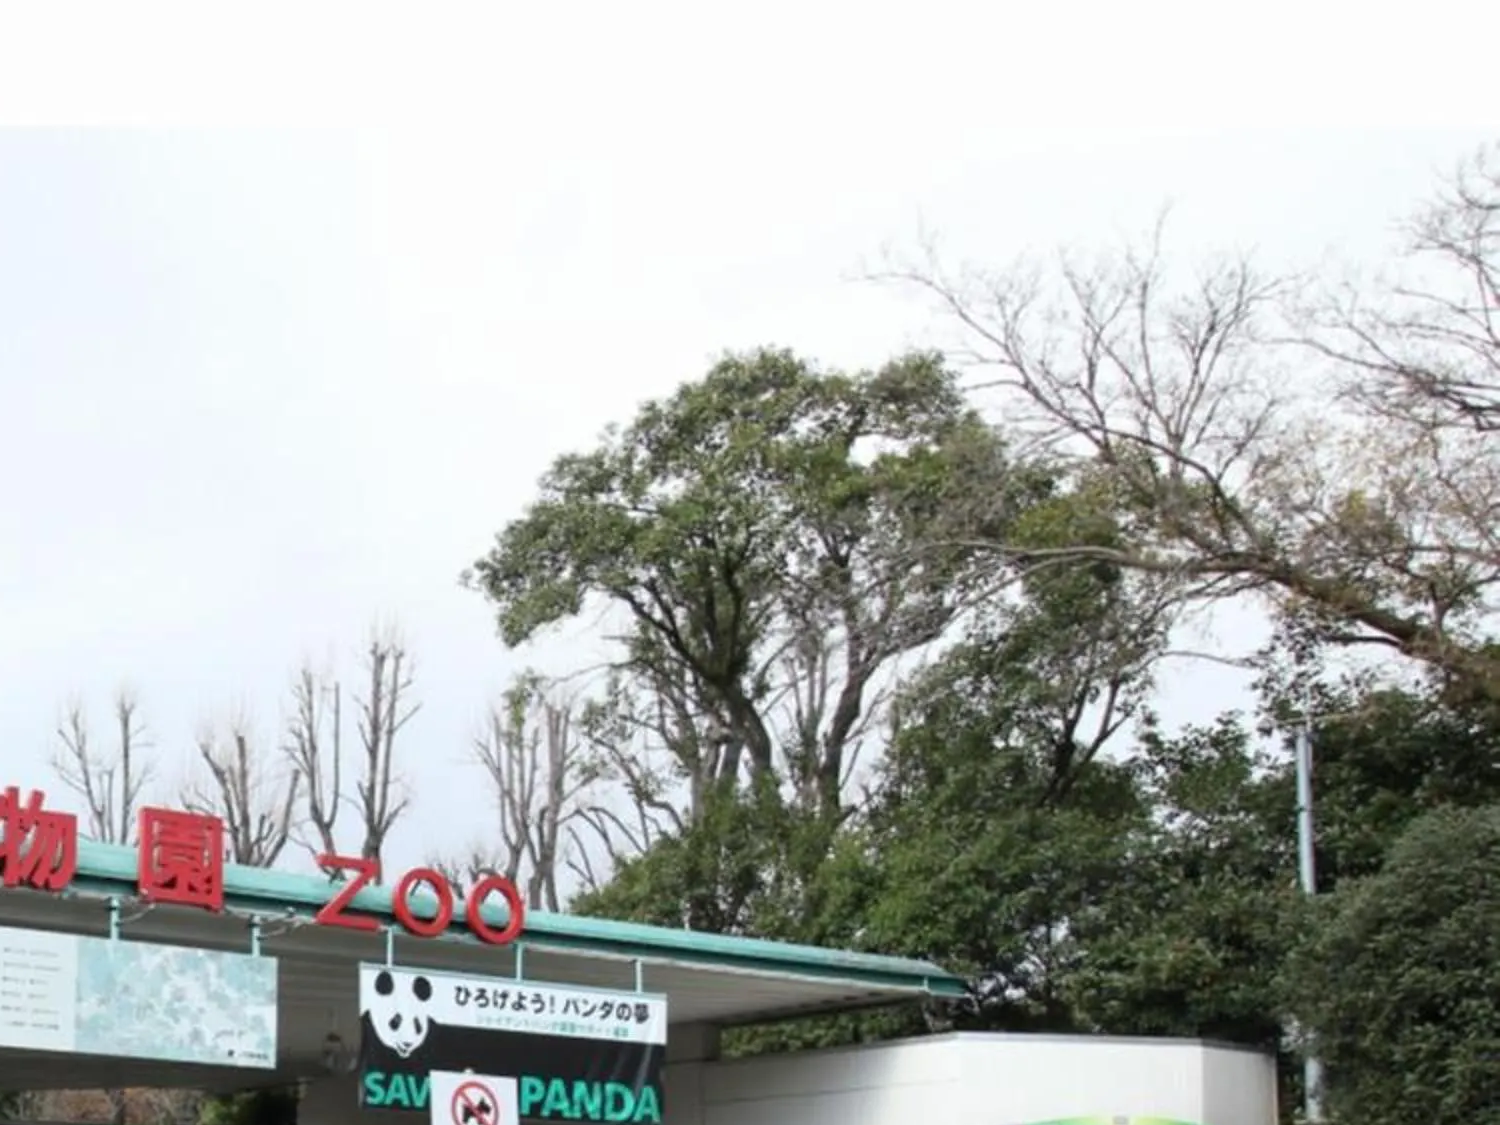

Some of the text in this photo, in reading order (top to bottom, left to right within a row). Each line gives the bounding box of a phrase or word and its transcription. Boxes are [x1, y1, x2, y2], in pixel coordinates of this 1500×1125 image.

[315, 852, 526, 945] ZOO
[364, 1070, 661, 1124] SAV PANDA
